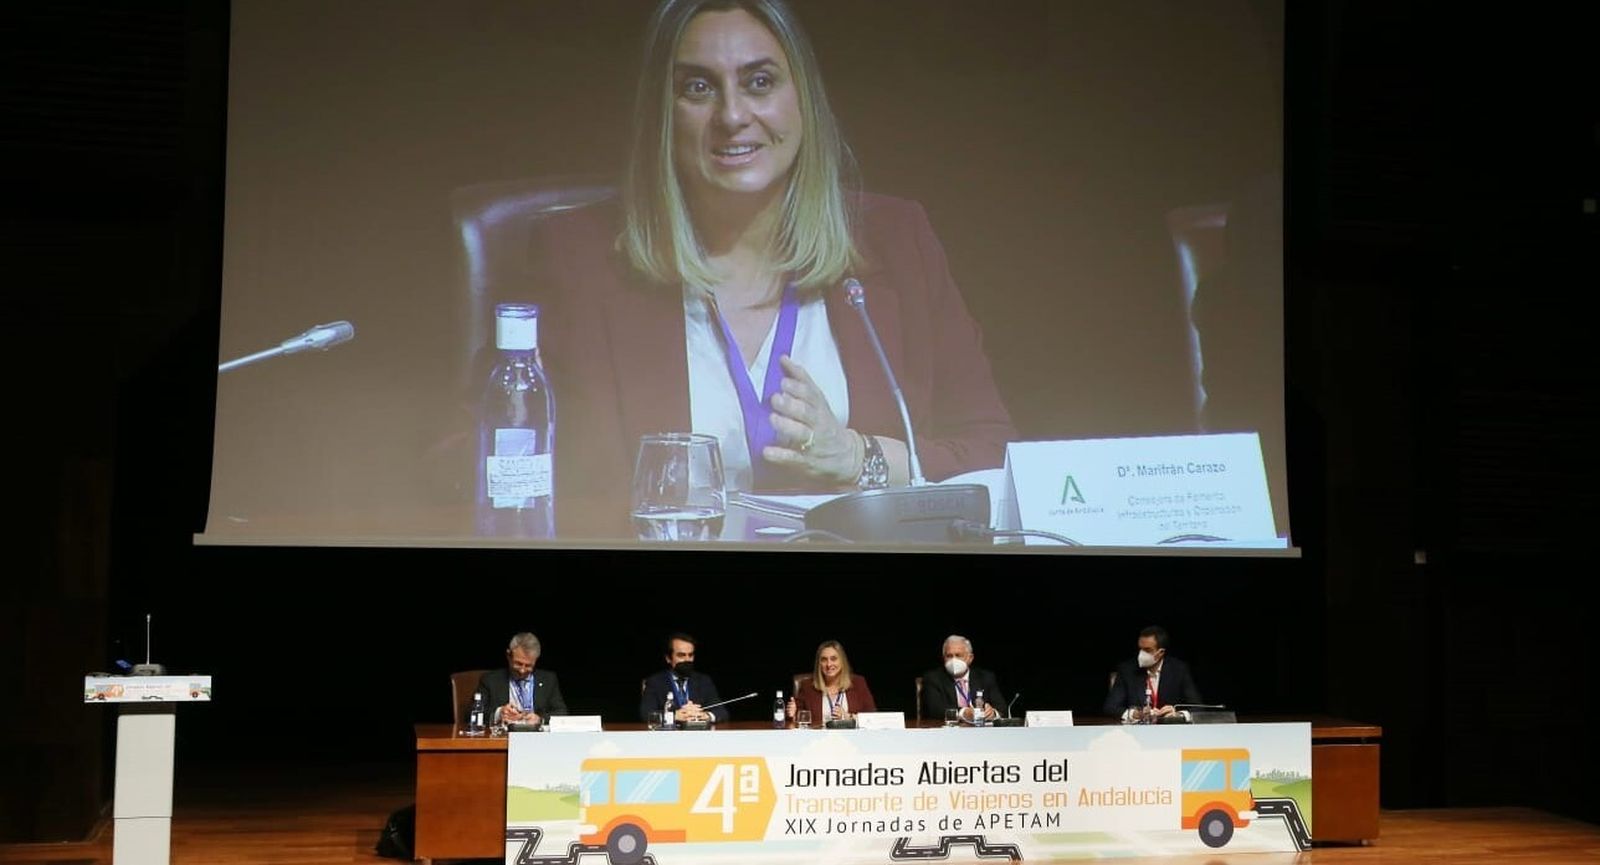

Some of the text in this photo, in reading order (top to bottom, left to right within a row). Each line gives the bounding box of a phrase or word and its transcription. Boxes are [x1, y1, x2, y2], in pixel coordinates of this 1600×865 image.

[1187, 461, 1226, 474] Carazo
[785, 759, 1069, 787] Jornadas Abiertas del
[785, 793, 902, 815] Transporte
[913, 791, 939, 811] de
[949, 790, 1032, 813] Viajeros
[1043, 791, 1067, 808] en
[785, 812, 1062, 834] XIX Jornadas de APETAM
